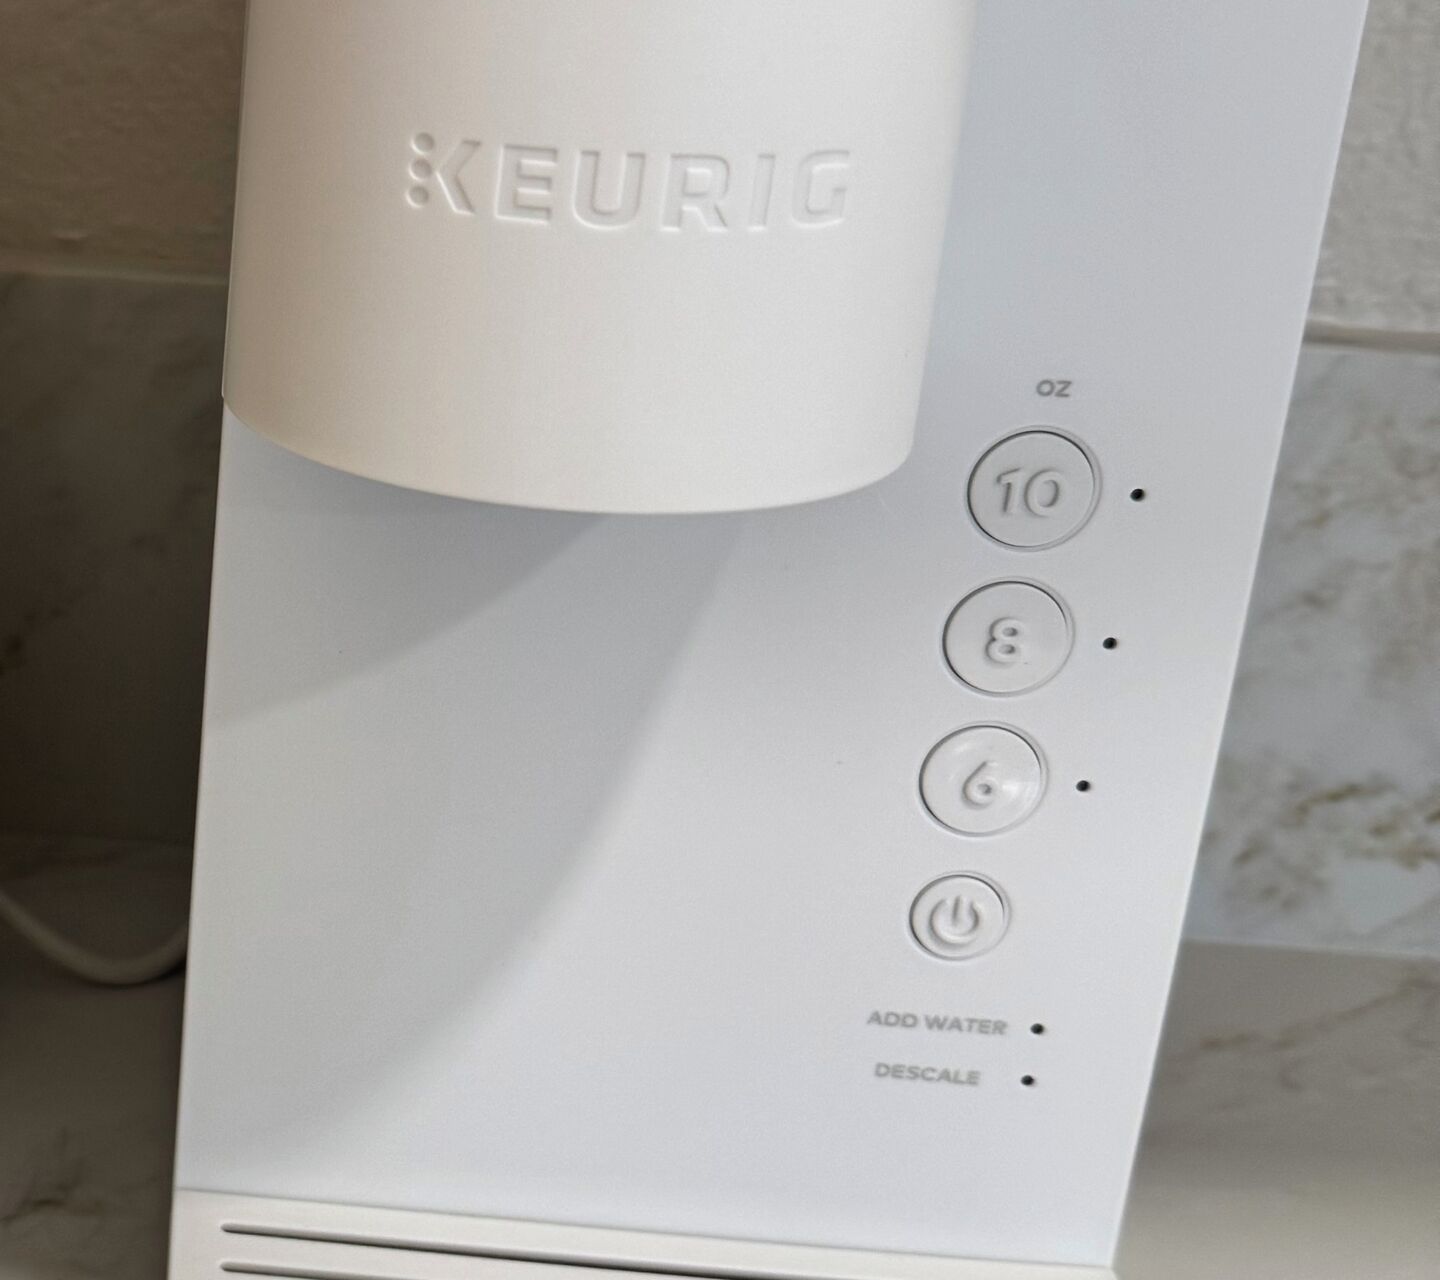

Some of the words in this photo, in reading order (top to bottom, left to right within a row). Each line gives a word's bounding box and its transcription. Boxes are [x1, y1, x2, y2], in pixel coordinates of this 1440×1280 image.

[406, 131, 852, 233] KEURIG
[995, 467, 1064, 519] 10
[984, 616, 1026, 667] 8
[961, 759, 1002, 809] 6
[867, 1009, 919, 1030] ADD
[925, 1014, 1009, 1037] WATER
[873, 1062, 982, 1087] DESCALE
